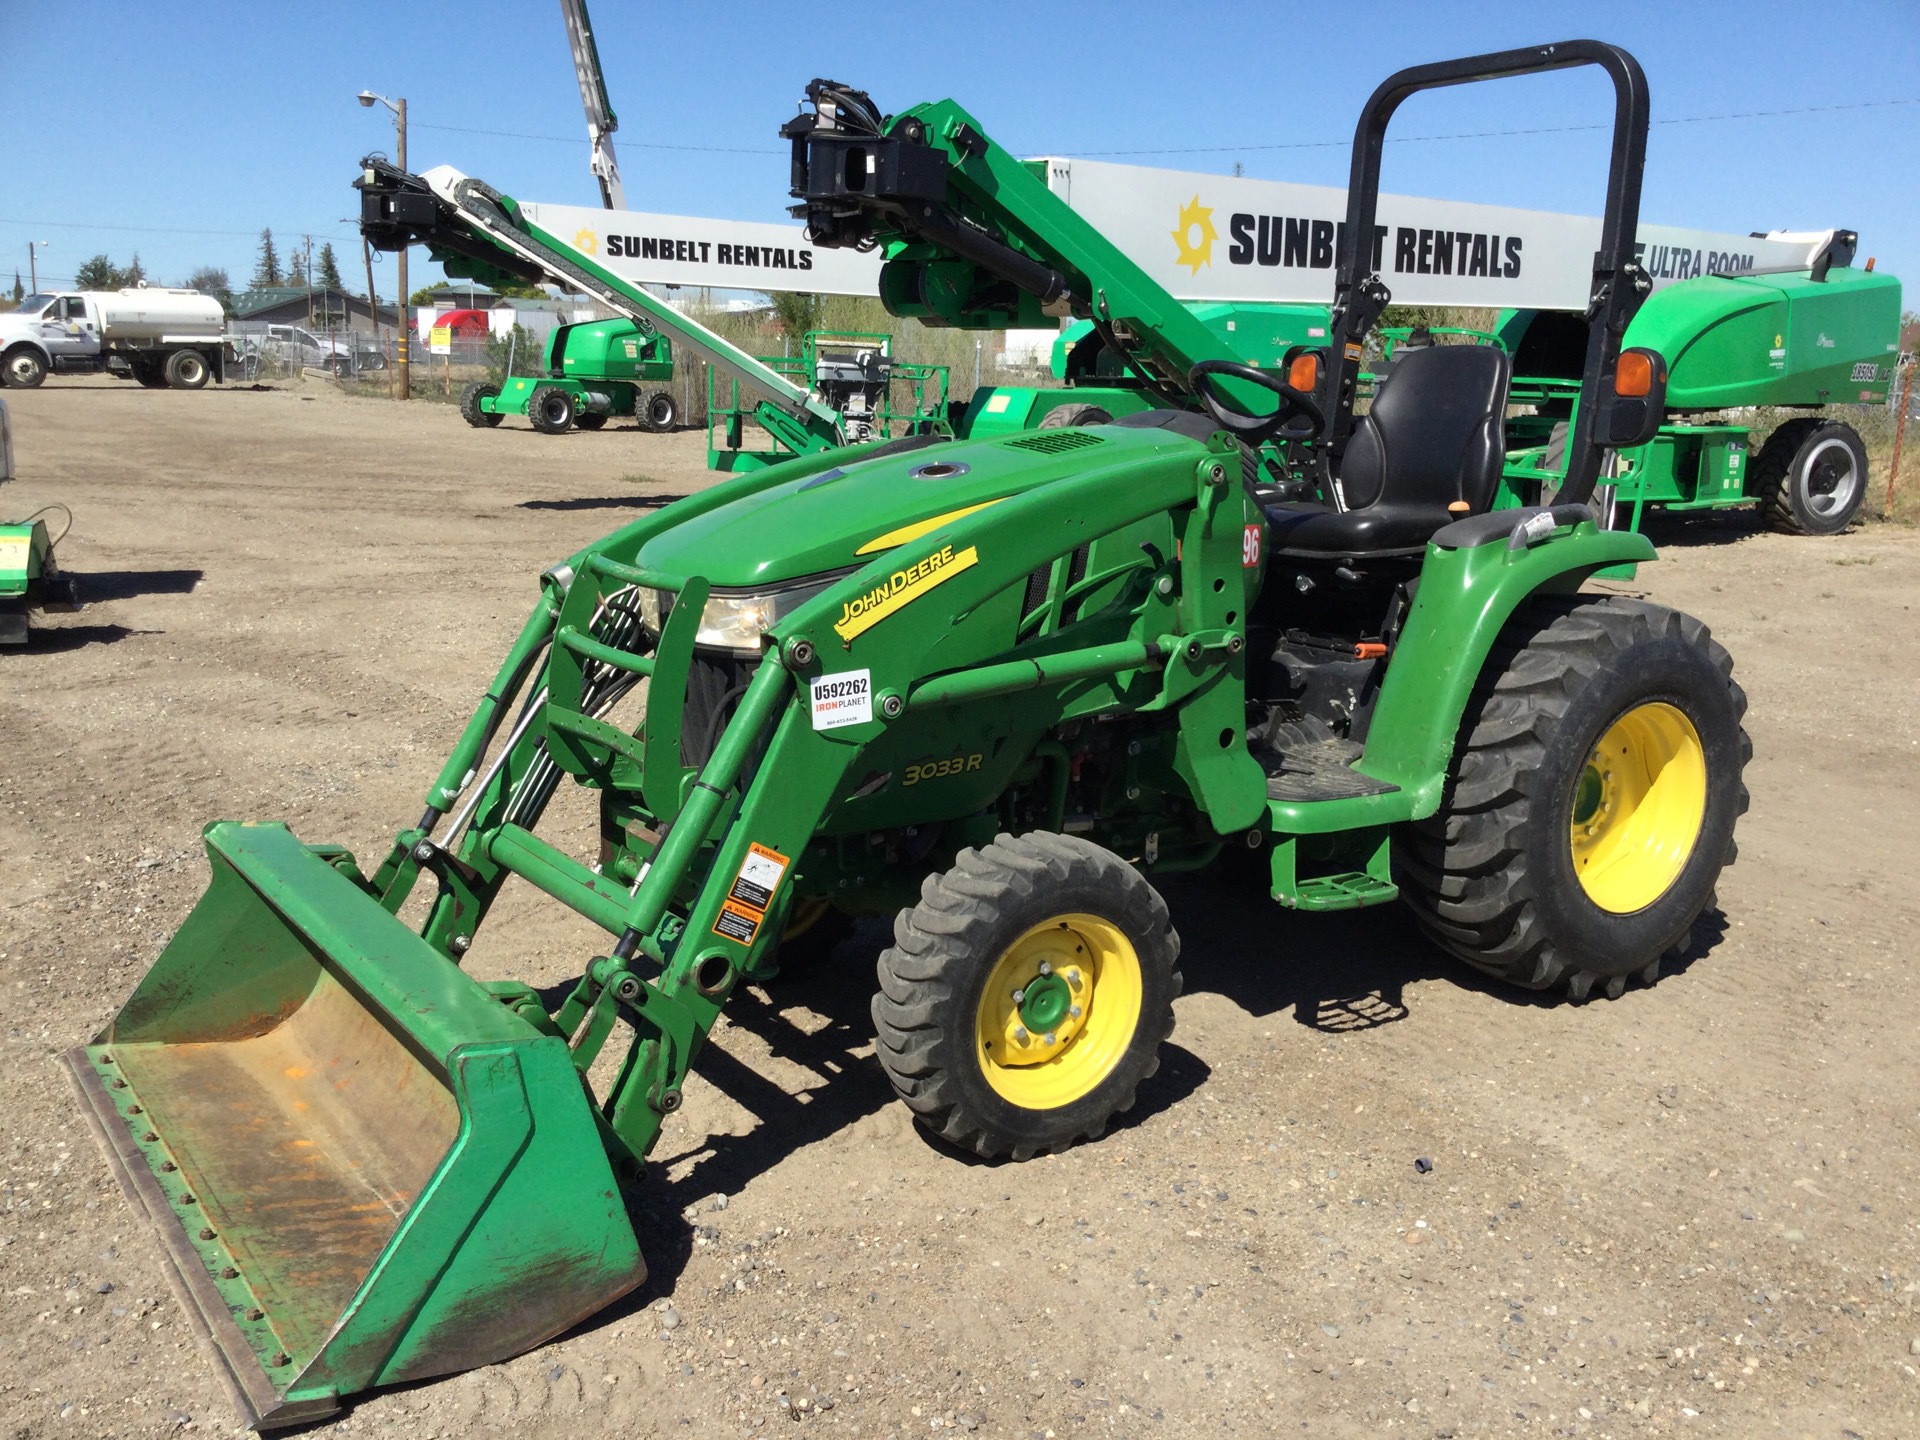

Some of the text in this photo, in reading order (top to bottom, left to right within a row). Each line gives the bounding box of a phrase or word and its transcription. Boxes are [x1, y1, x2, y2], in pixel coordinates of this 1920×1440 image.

[607, 234, 812, 270] SUNBELT RENTALS
[1229, 213, 1522, 278] SUNBT RENTALS
[1650, 245, 1702, 279] ULTRA
[1706, 251, 1754, 276] BOOM
[1243, 529, 1259, 564] 96
[838, 544, 955, 626] JOHN DEERE
[814, 678, 867, 701] U592262
